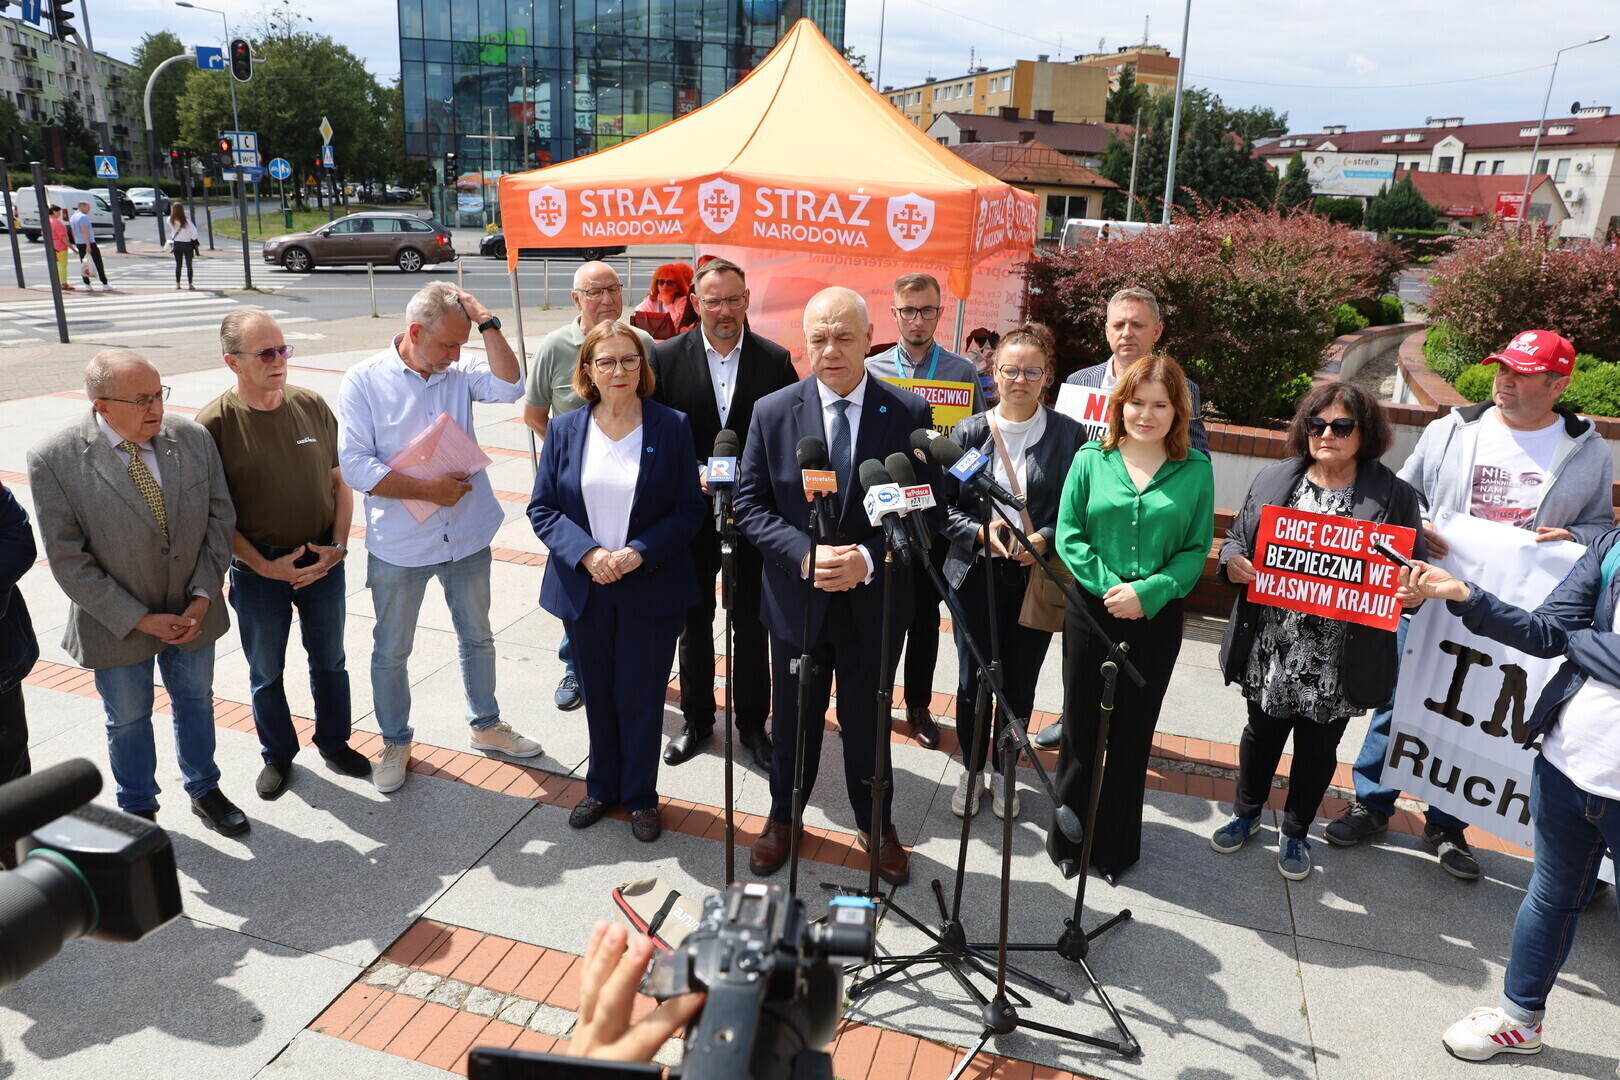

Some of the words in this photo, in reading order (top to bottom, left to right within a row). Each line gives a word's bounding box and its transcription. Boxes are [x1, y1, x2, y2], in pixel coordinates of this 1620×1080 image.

[242, 156, 255, 164] WC
[1352, 157, 1379, 166] strefa
[579, 179, 684, 218] STRAŻ
[755, 187, 871, 227] STRAŻ
[581, 220, 683, 237] NARODOWA
[752, 221, 869, 248] NARODOWA
[1481, 467, 1509, 479] NIE
[1480, 486, 1503, 494] NAM
[1274, 516, 1318, 548] CHCĘ
[1320, 524, 1364, 552] CZUĆ
[1265, 544, 1363, 583] BEZPIECZNA
[1368, 562, 1395, 588] WE
[1255, 571, 1334, 607] WŁASNYM
[1335, 587, 1397, 620] KRAJU!
[1388, 731, 1532, 826] Ruch
